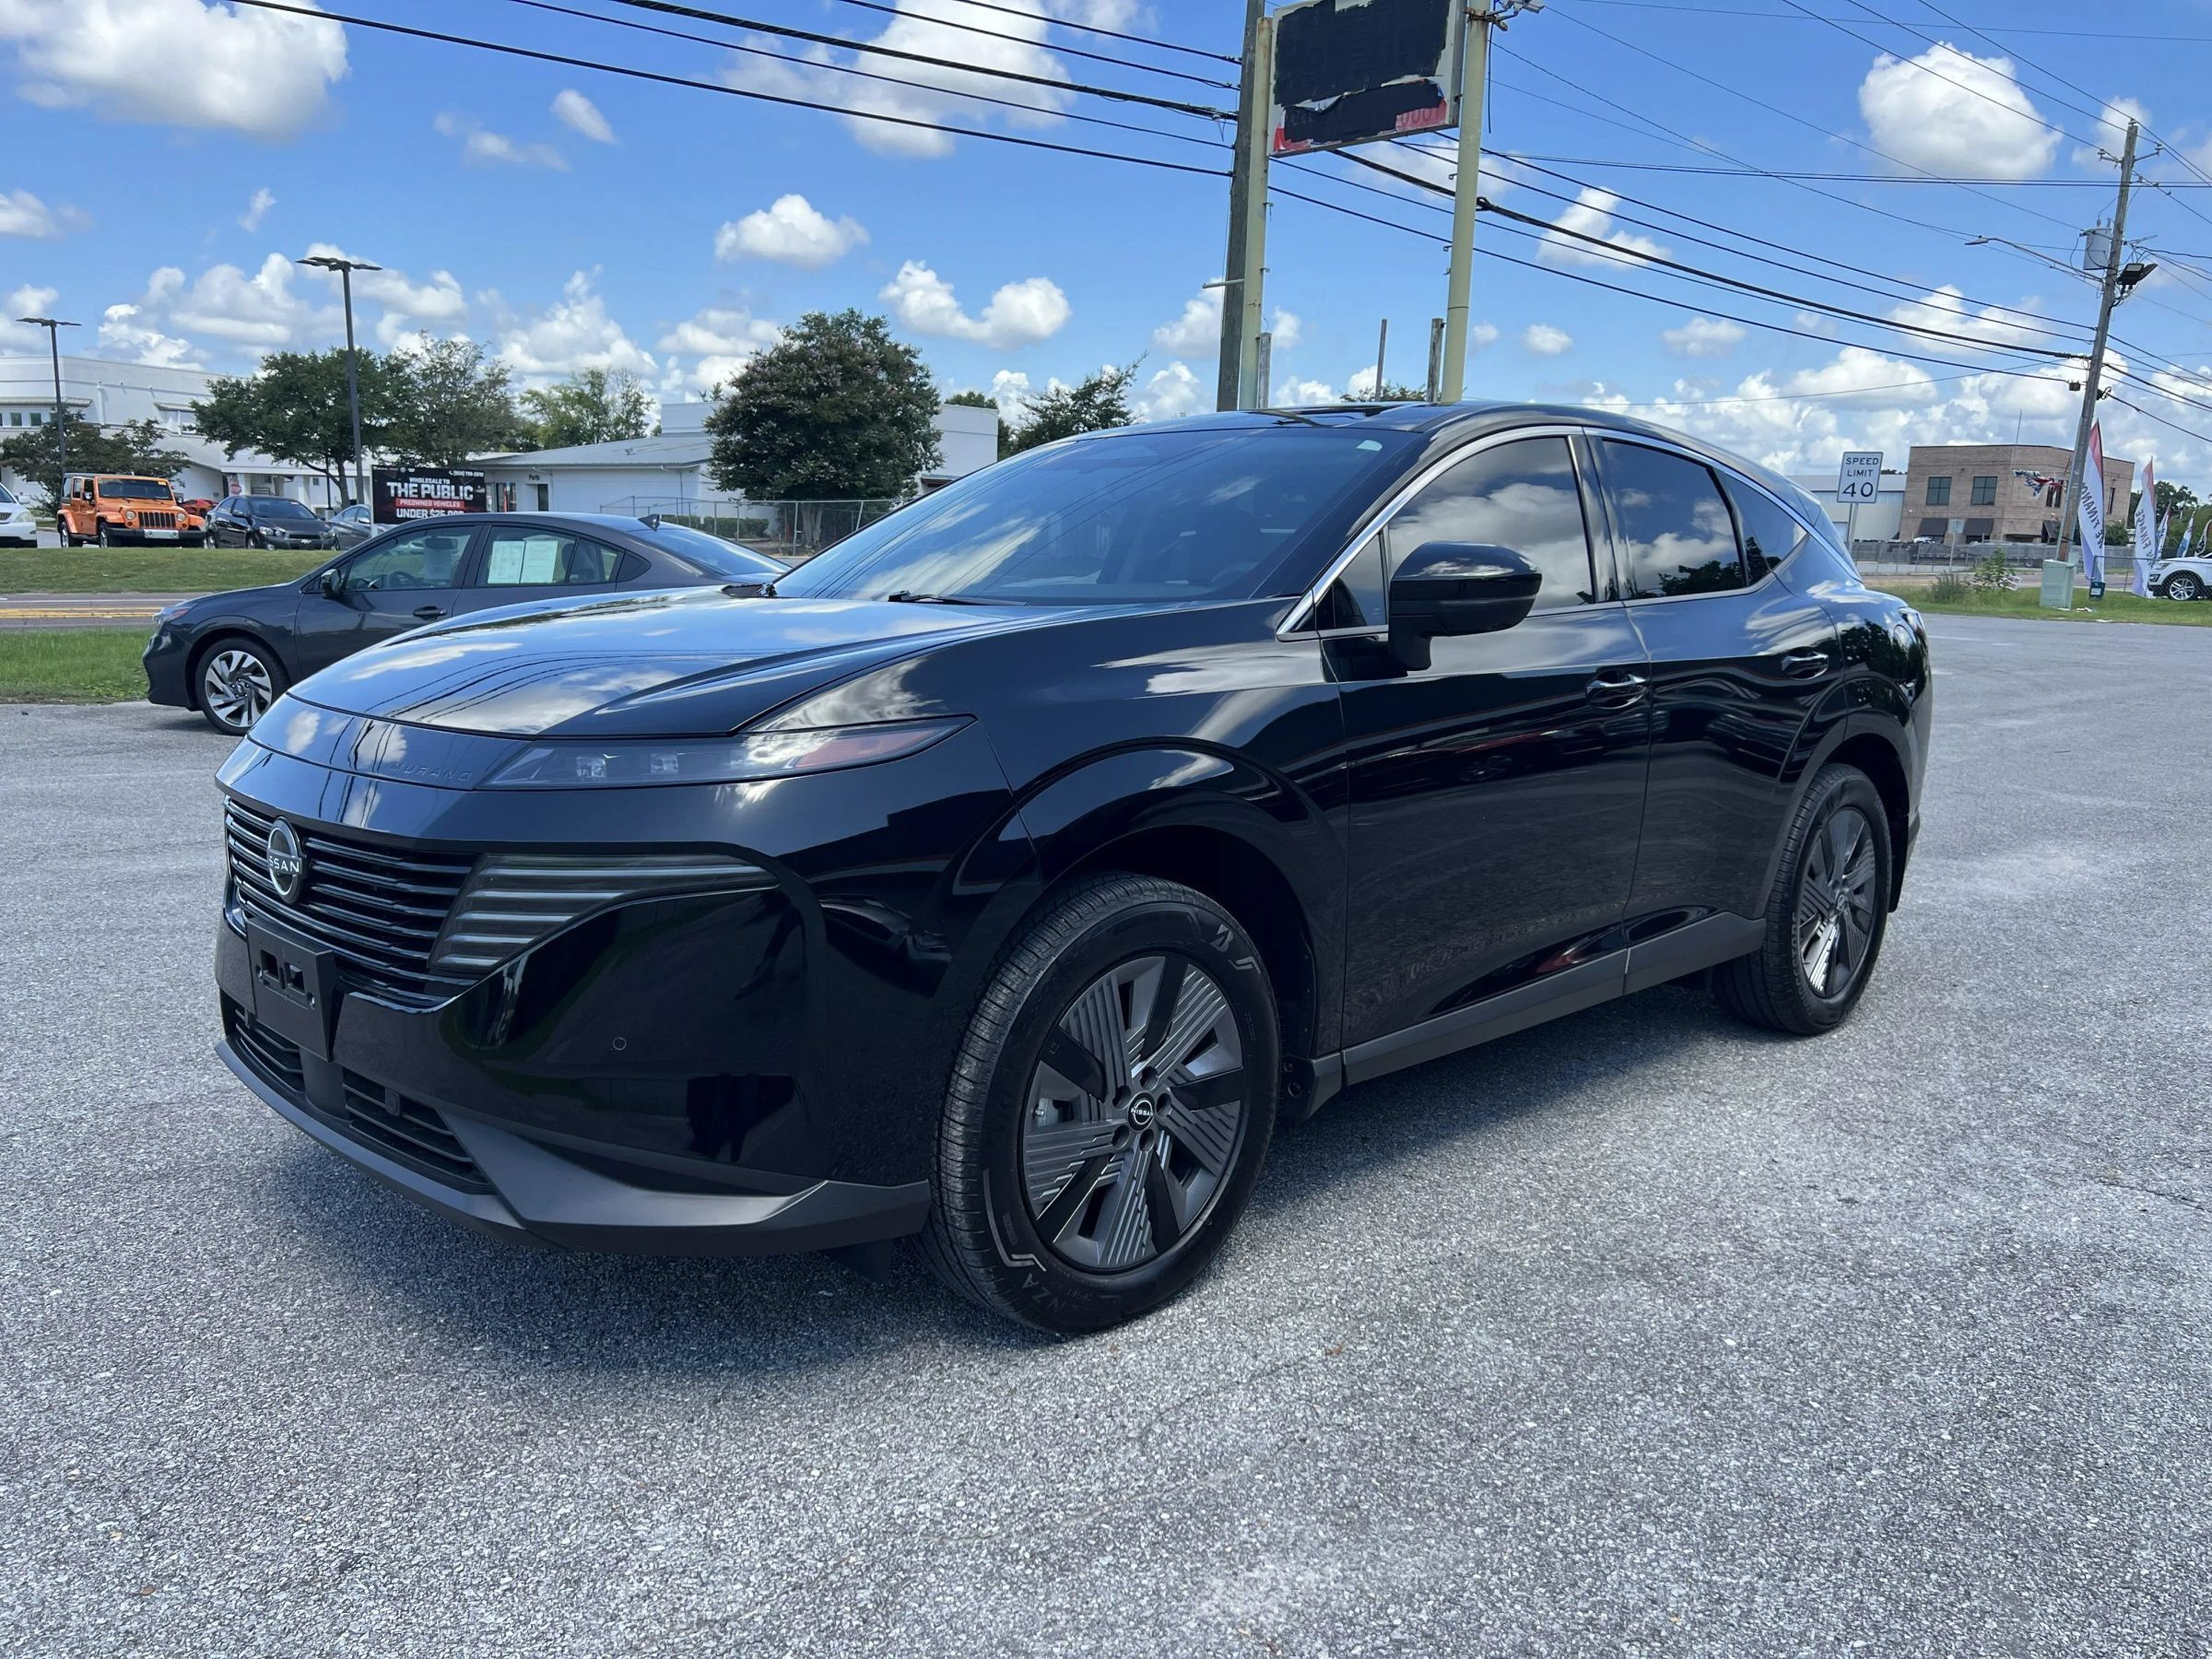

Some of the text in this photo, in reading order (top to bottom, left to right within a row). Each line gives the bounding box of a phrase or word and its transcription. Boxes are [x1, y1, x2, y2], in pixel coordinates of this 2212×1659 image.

[1845, 457, 1879, 465] SPEED
[1847, 469, 1874, 477] LIMIT
[409, 477, 441, 485] WHOLESALE
[386, 482, 474, 500] THE PUBLIC
[1842, 482, 1874, 498] 40
[399, 499, 433, 507] PREOWNED
[396, 508, 429, 519] UNDER
[390, 762, 473, 782] MURANO
[268, 854, 300, 873] SSAN
